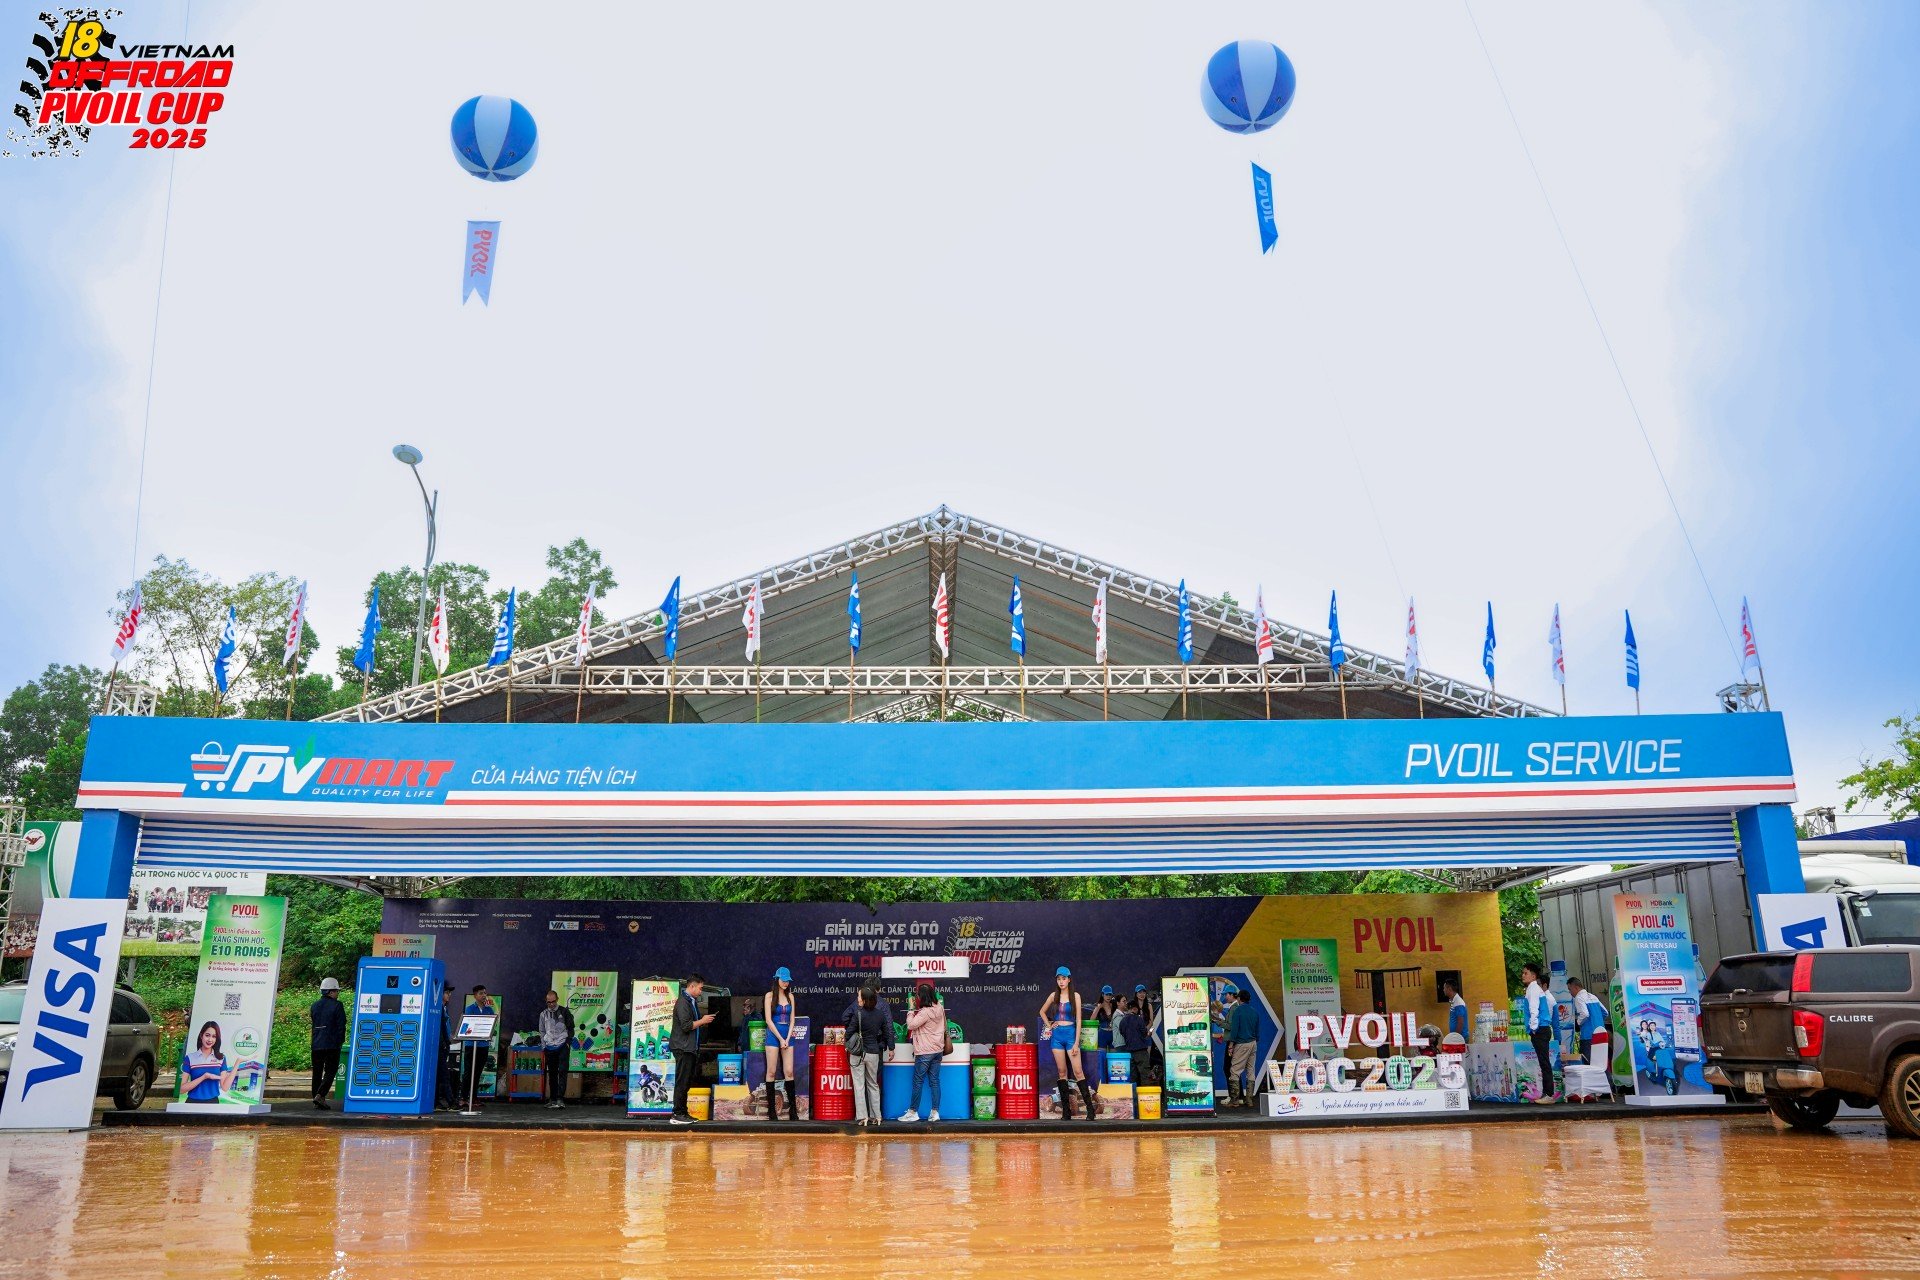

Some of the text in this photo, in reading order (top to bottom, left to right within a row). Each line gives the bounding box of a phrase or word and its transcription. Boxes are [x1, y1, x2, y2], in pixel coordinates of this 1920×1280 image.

[1405, 739, 1682, 778] PVOIL SERVICE
[472, 765, 637, 787] CỬA HÀNG TIỆN ÍCH
[312, 788, 435, 798] QUALITY FOR LIFE
[231, 904, 259, 916] PVOIL
[825, 919, 939, 936] GIẢI ĐUA XE ÔTÔ
[960, 922, 976, 937] 18
[1354, 917, 1443, 954] PVOIL
[832, 936, 864, 952] HÌNH
[867, 936, 900, 954] VIỆT
[903, 938, 935, 951] NAM
[955, 938, 1025, 949] OFFROAD
[211, 945, 270, 957] E10 RON95
[1300, 946, 1319, 954] PVOIL
[815, 956, 882, 969] PVOIL CU
[993, 950, 1021, 963] CUP
[919, 960, 946, 971] PVOIL
[986, 965, 1015, 974] 2025
[576, 976, 599, 987] PVOIL
[1181, 982, 1199, 990] PVOIL
[1290, 976, 1305, 984] E10
[652, 986, 669, 994] PVOIL
[22, 922, 108, 1102] VISA
[1829, 1015, 1874, 1023] CALIBRE
[1296, 1012, 1430, 1050] PVOIL
[820, 1074, 852, 1090] PVOIL
[1000, 1074, 1032, 1090] PVOIL
